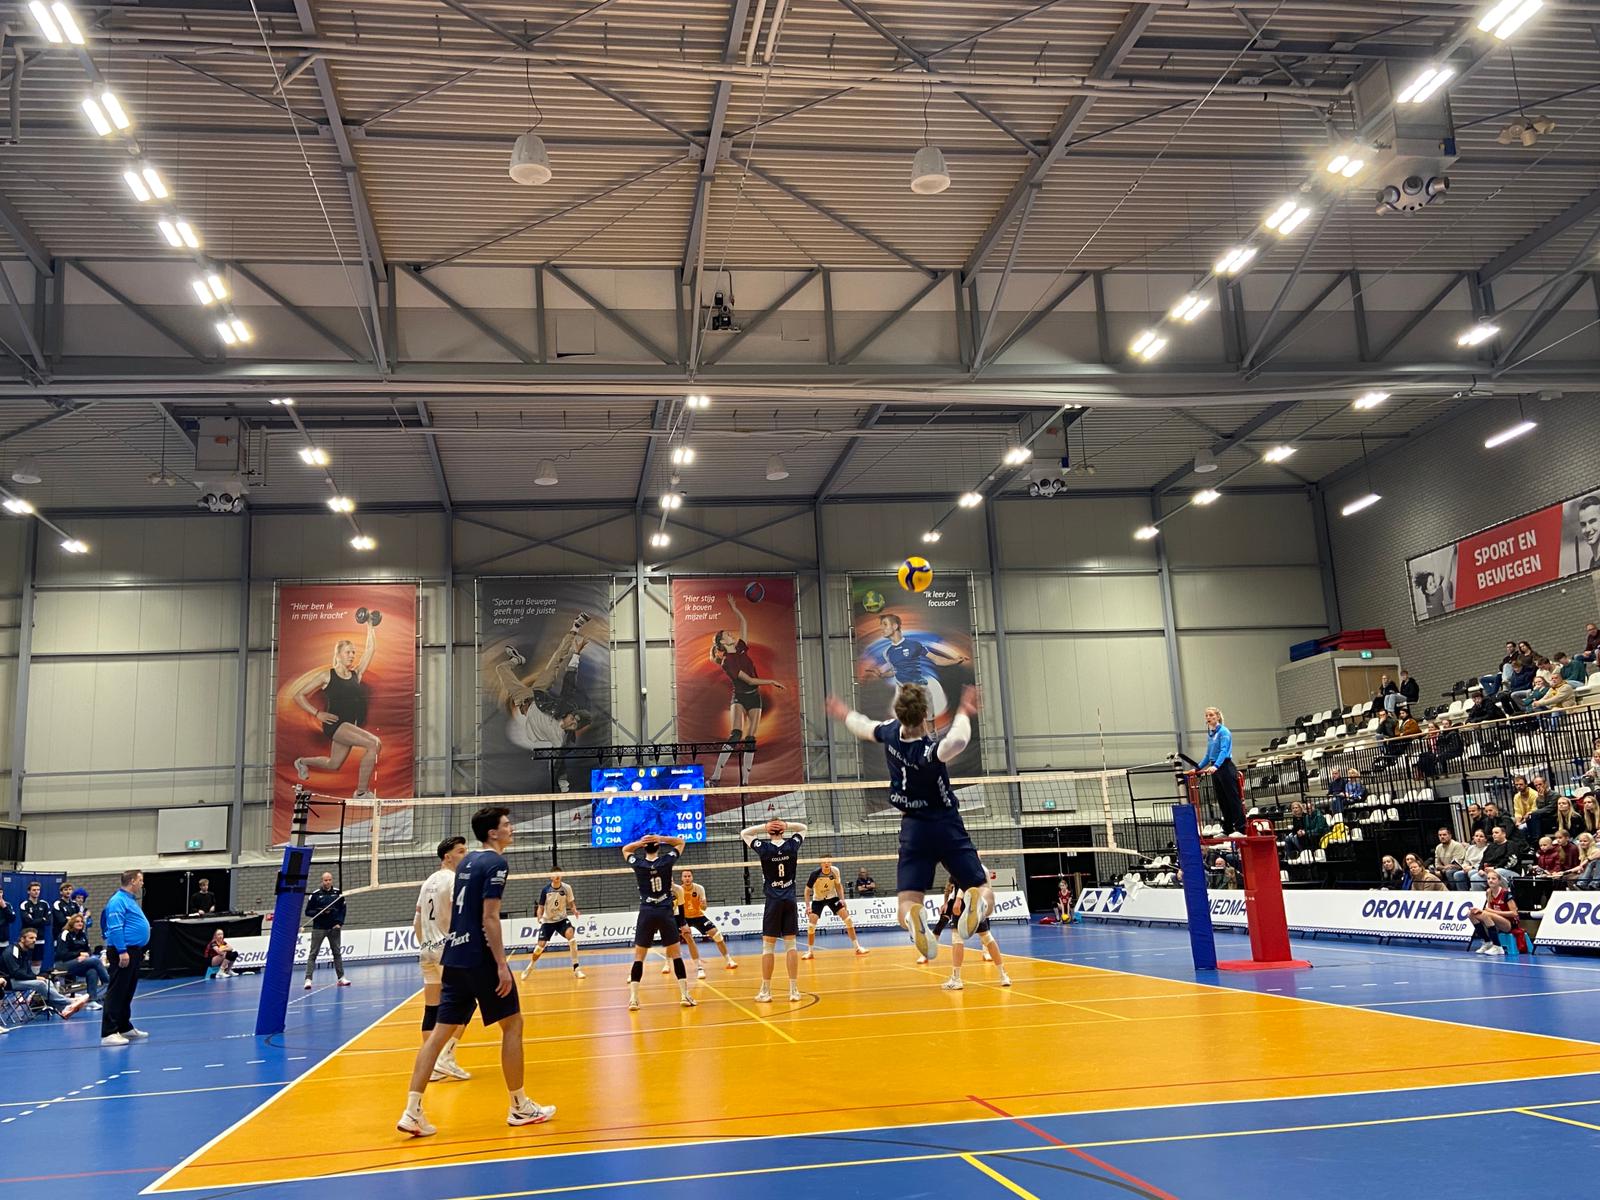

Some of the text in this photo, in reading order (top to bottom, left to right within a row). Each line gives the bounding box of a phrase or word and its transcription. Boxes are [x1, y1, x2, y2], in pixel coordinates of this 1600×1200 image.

[1474, 529, 1537, 566] SPORT EN
[1477, 554, 1541, 589] BEWEGEN
[700, 595, 716, 603] stijg
[932, 590, 945, 599] leer
[945, 590, 957, 600] jou
[310, 602, 325, 610] ben
[325, 602, 334, 610] ik
[525, 598, 557, 607] Bewegen
[301, 612, 318, 621] mijn
[493, 607, 556, 616] geeft mij de juiste
[685, 612, 708, 622] mijzelf
[638, 769, 658, 778] 0 0
[901, 766, 907, 791] 1
[595, 816, 622, 824] 0 T/O
[676, 811, 702, 821] T/O 0
[595, 826, 622, 835] 0 SUB
[676, 821, 702, 831] SUB 0
[595, 836, 603, 845] 0
[696, 831, 703, 841] 0
[778, 863, 785, 878] 8
[650, 876, 662, 893] 10
[456, 886, 467, 914] 4
[554, 899, 559, 907] 6
[993, 896, 1022, 913] next
[428, 898, 436, 921] 2
[603, 924, 638, 937] tours
[1439, 923, 1467, 931] GROUP
